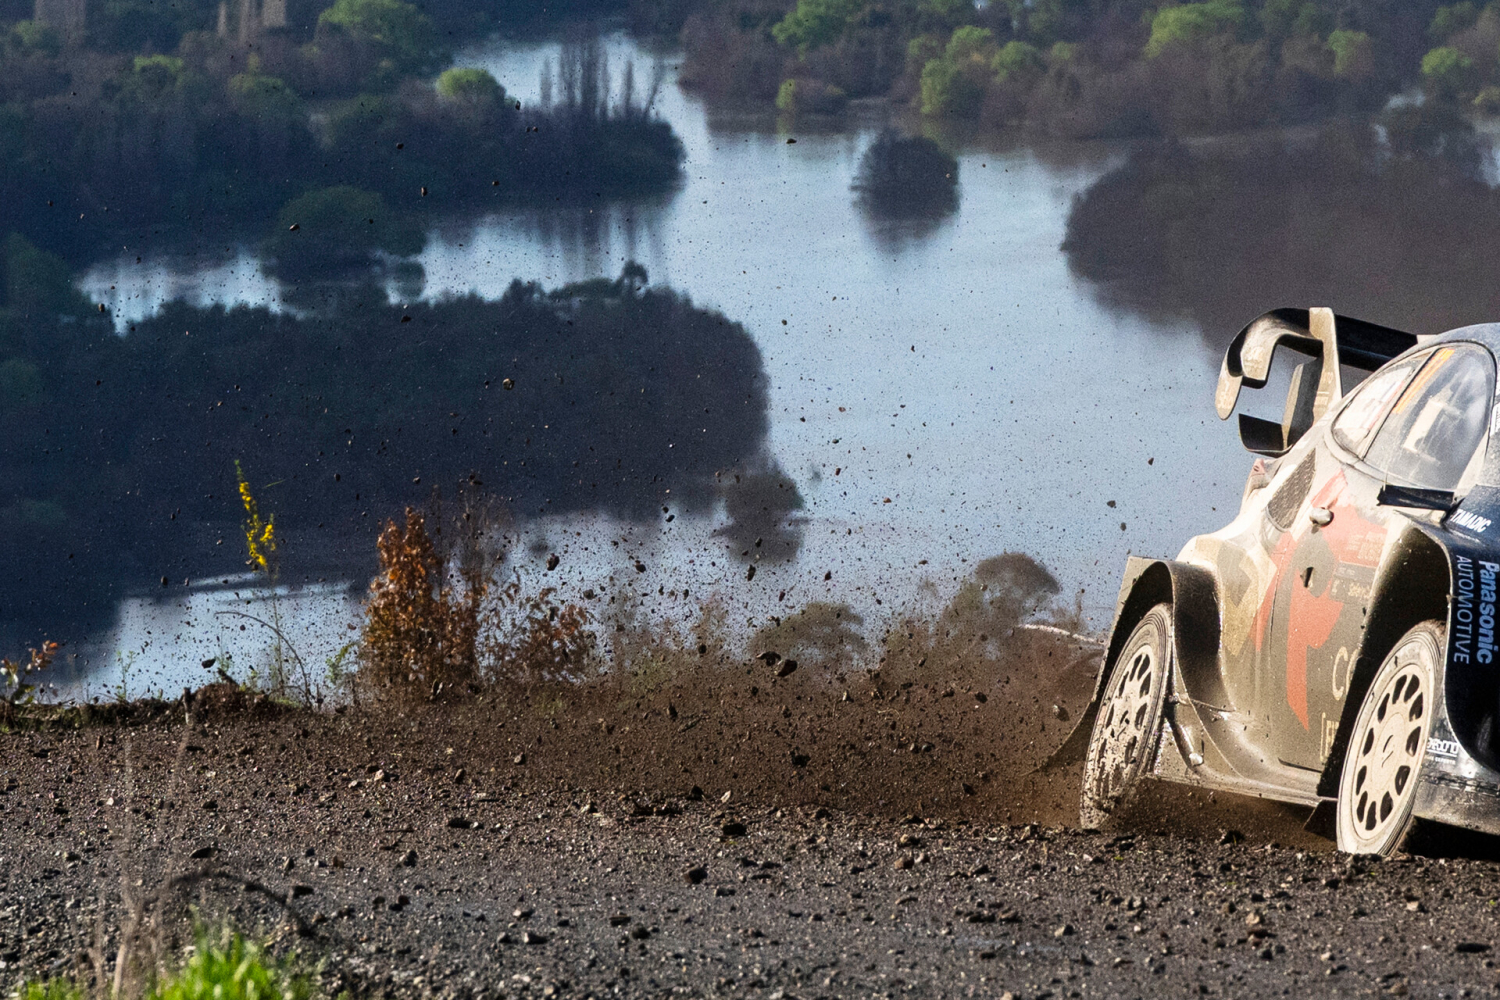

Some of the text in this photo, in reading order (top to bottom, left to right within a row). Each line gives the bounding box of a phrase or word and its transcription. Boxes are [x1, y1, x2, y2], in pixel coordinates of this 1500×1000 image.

[1449, 508, 1492, 533] TAMADIC
[1453, 555, 1474, 664] AUTOMOTIVE
[1476, 560, 1500, 664] Panasonic
